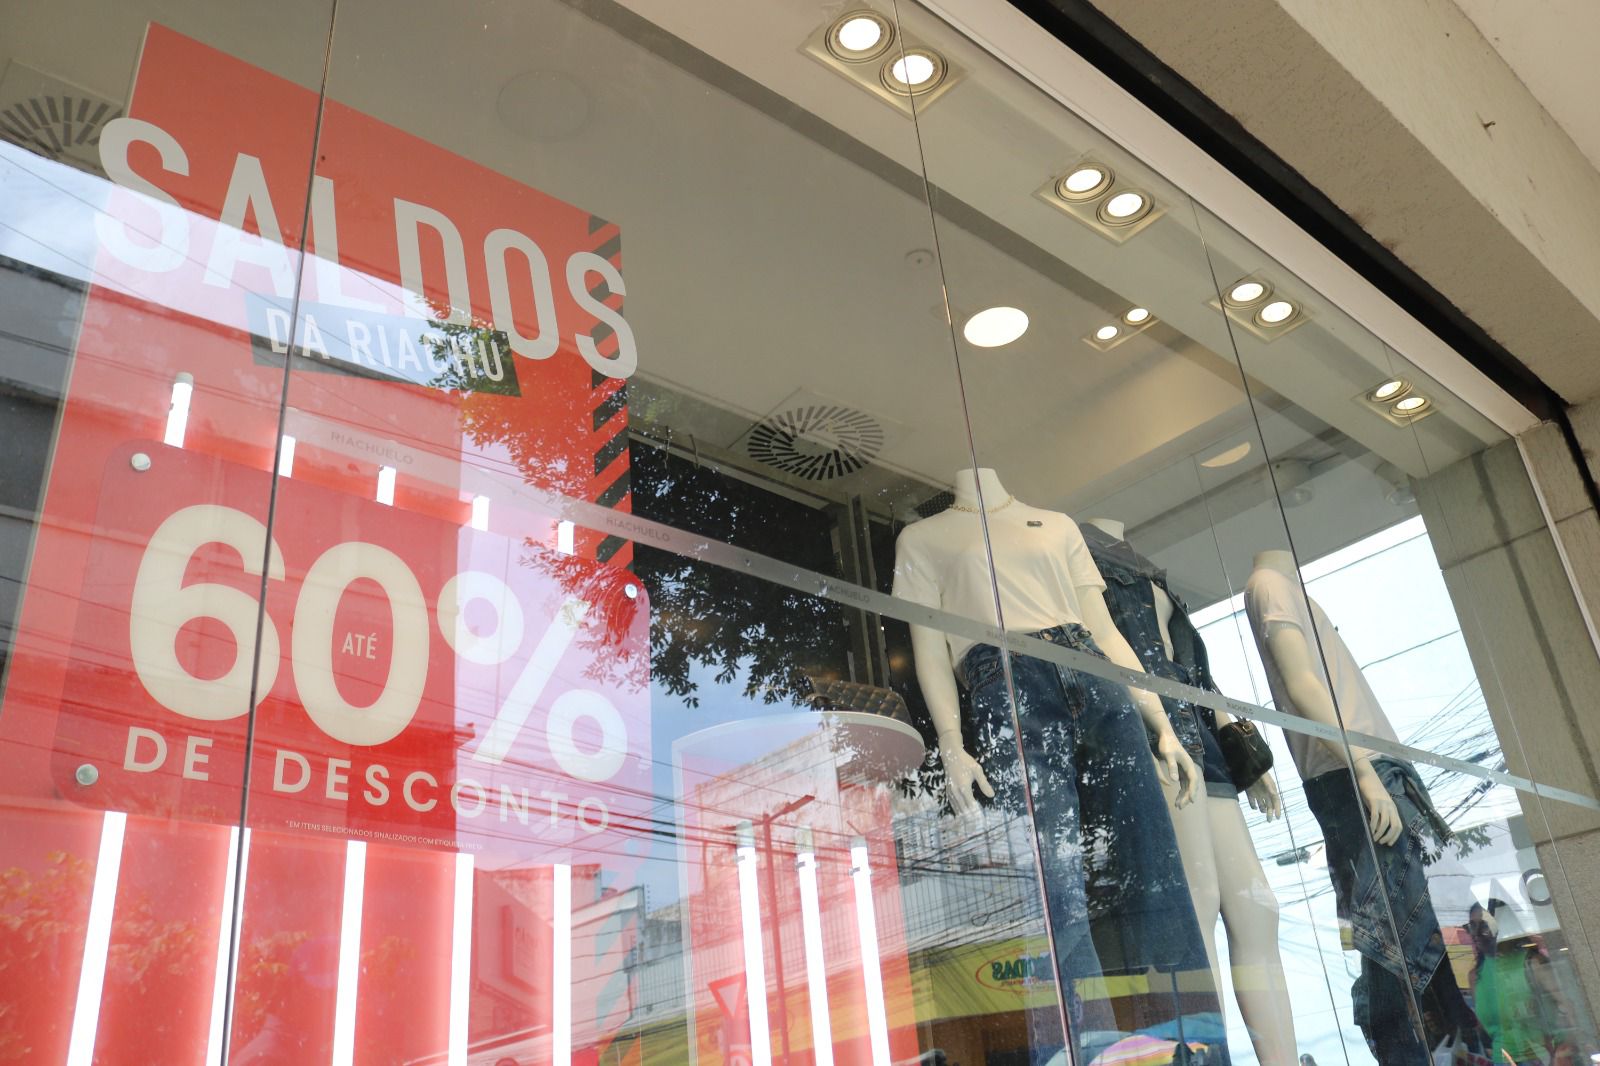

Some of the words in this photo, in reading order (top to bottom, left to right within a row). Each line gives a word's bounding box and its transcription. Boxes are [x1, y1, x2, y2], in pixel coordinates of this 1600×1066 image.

[94, 116, 638, 379] SALDOS
[266, 308, 331, 360] DA
[346, 319, 504, 382] RIACHU
[331, 431, 414, 466] RIACHUELO
[606, 516, 670, 543] RIACHUELO
[130, 503, 627, 783] 60%
[342, 632, 378, 660] ATÉ
[123, 725, 214, 782] DE
